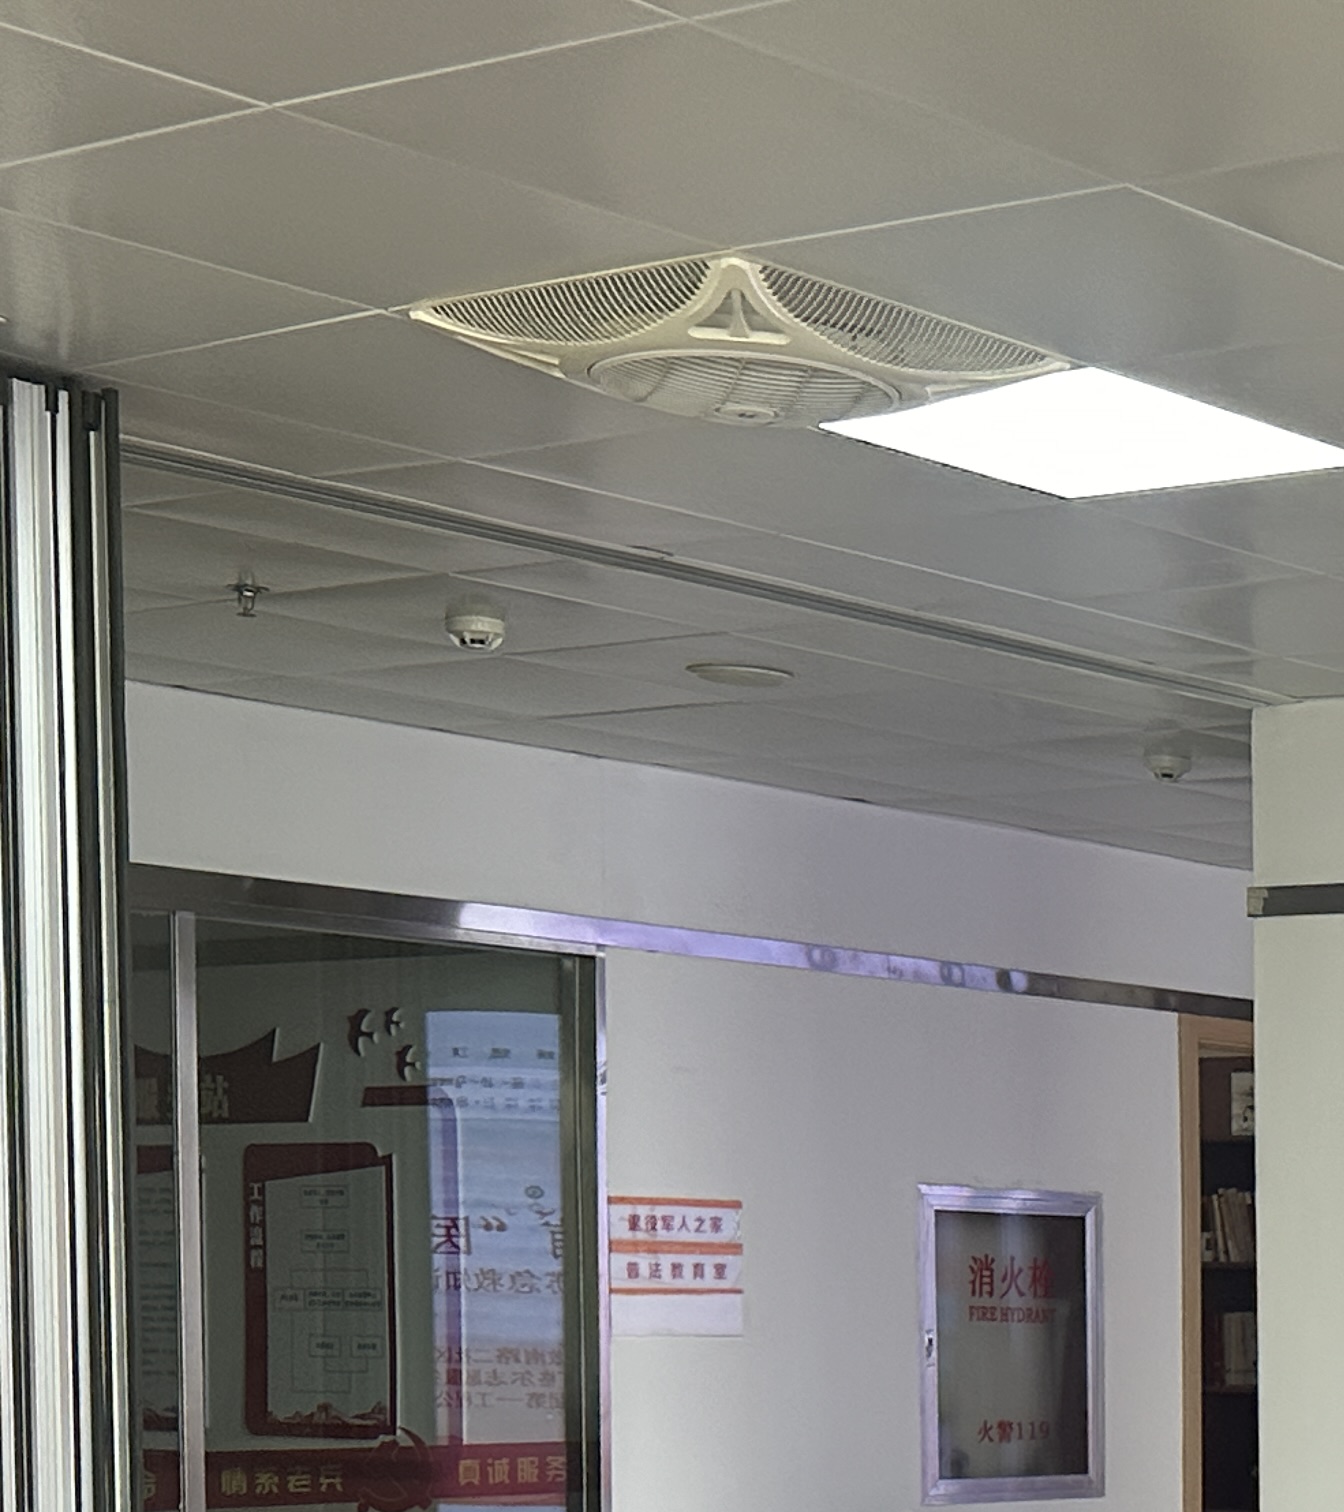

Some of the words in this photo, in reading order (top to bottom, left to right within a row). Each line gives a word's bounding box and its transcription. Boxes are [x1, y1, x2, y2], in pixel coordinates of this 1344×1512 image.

[627, 1213, 723, 1234] 退役军人之家
[968, 1253, 1056, 1300] 消火栓
[968, 1305, 998, 1323] FIRE
[999, 1306, 1057, 1324] HYDRANT
[457, 1455, 567, 1485] 真诚服务
